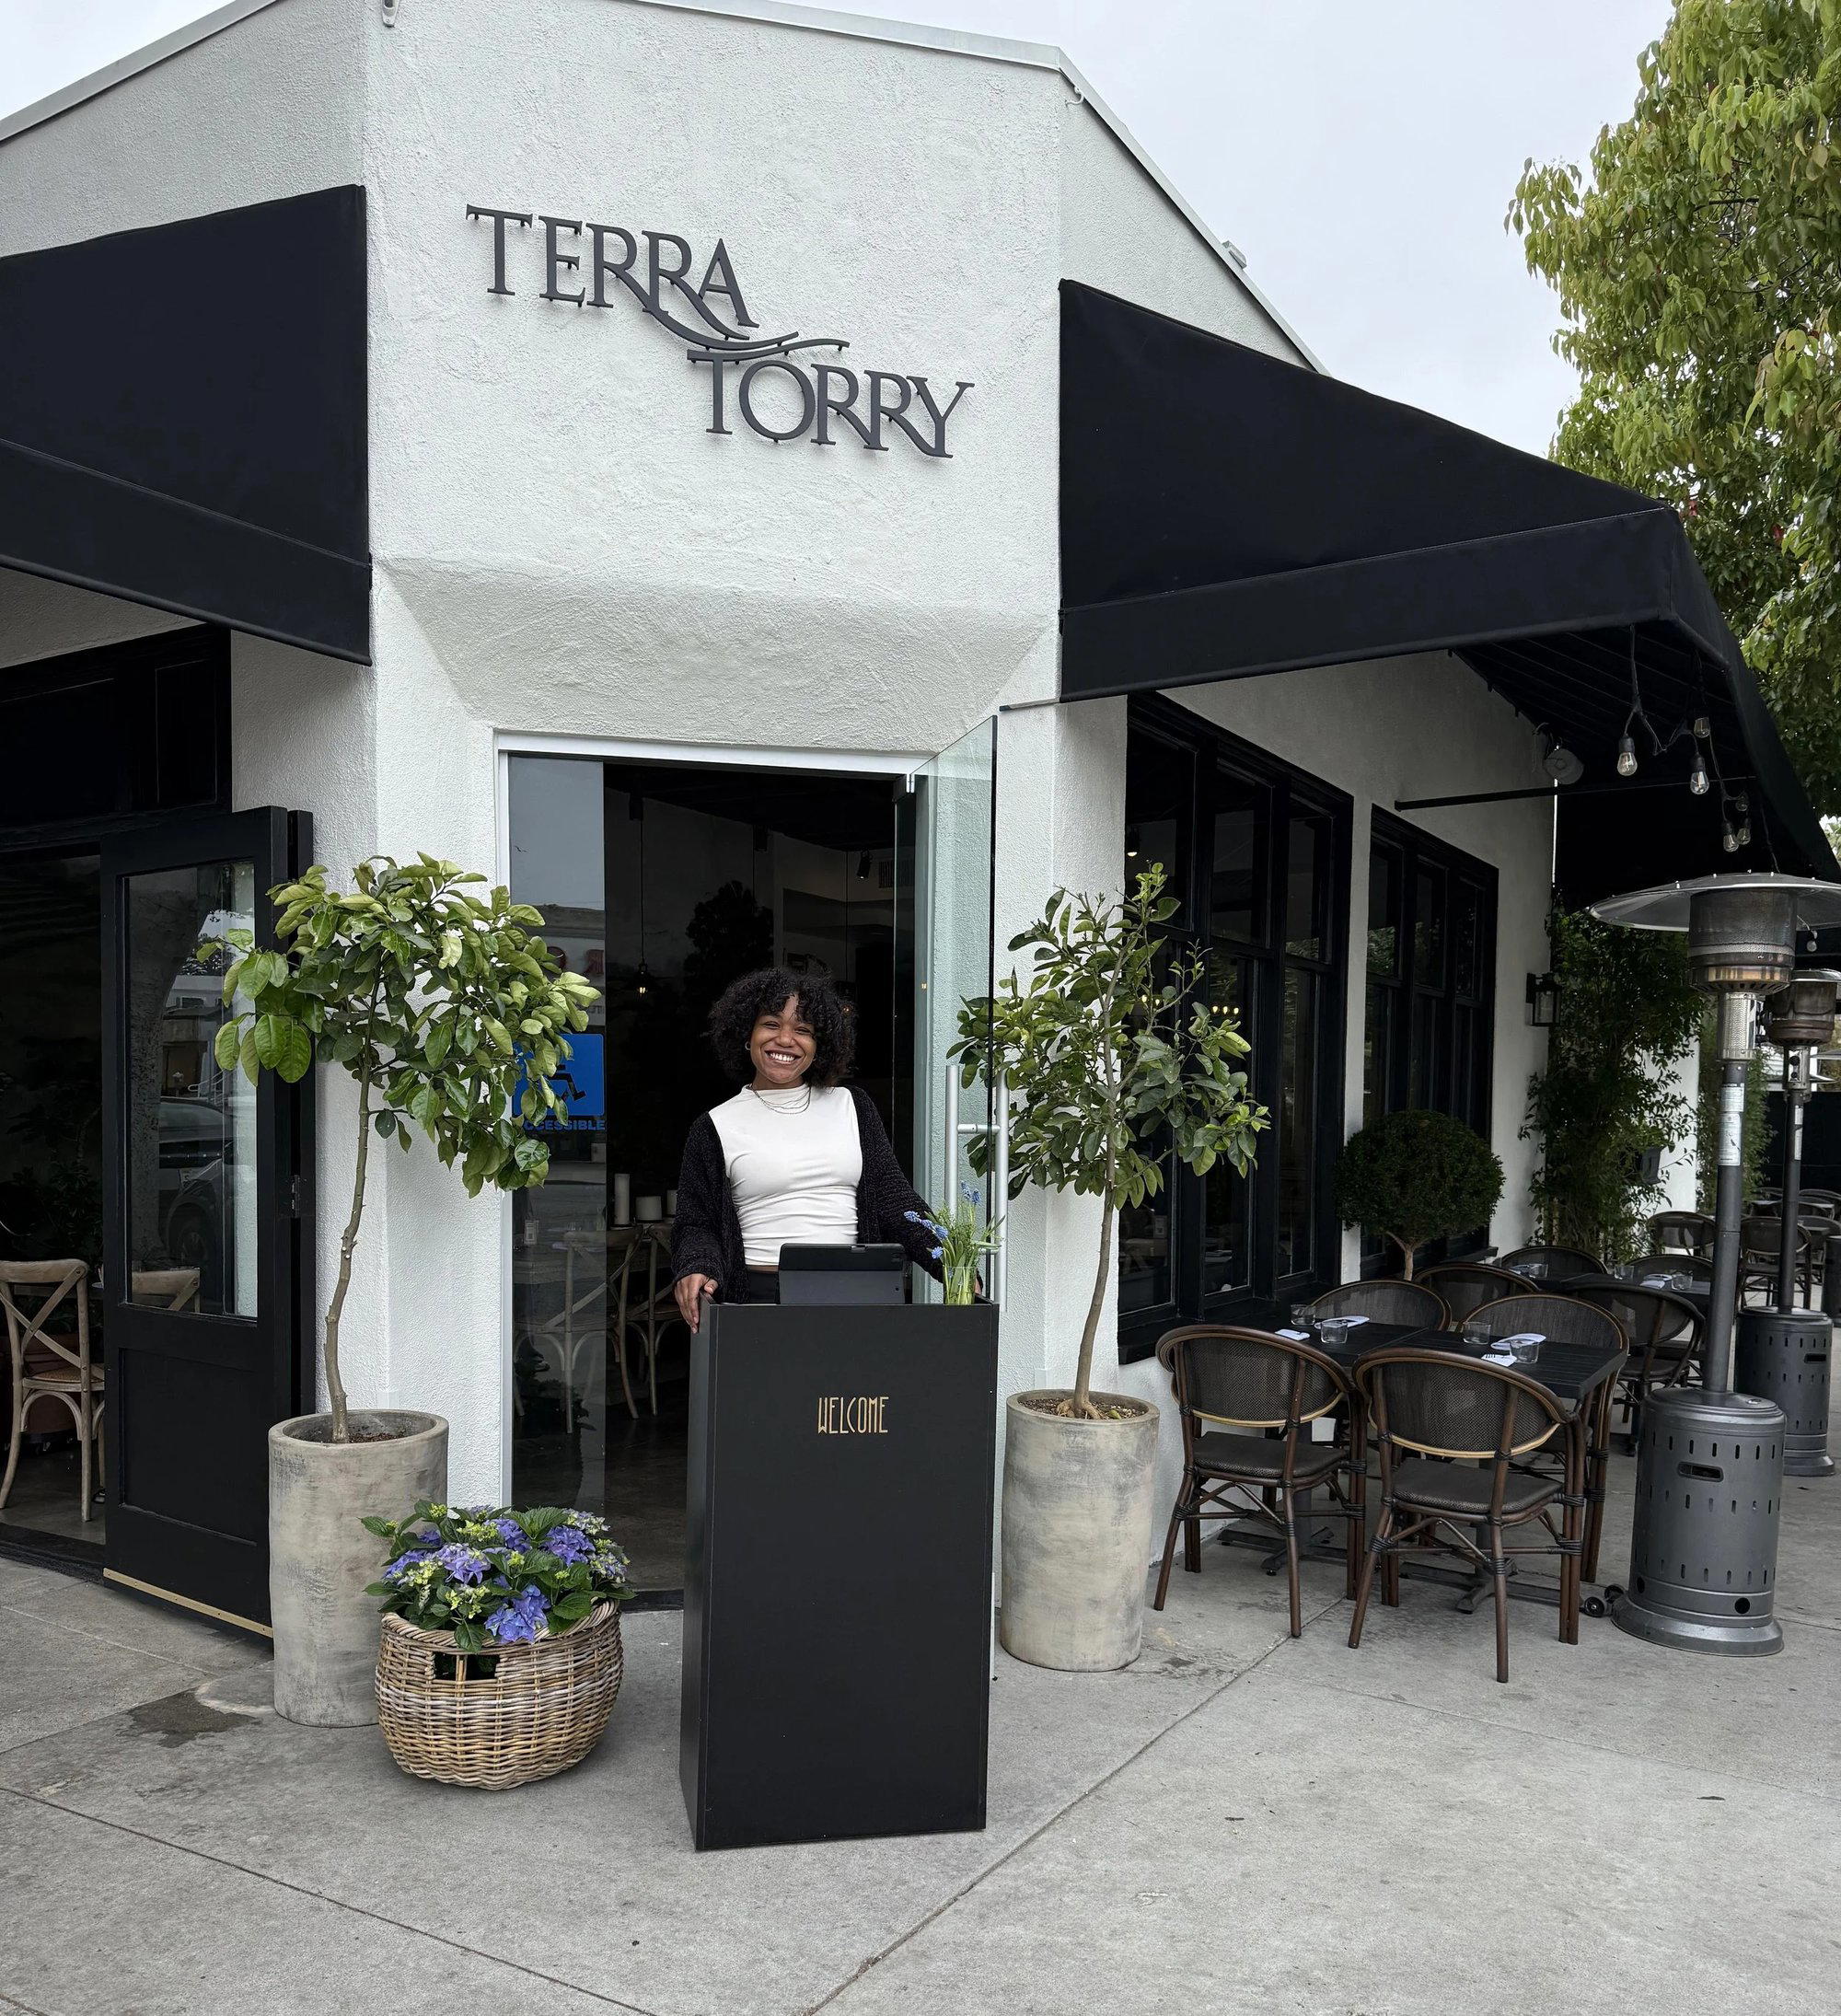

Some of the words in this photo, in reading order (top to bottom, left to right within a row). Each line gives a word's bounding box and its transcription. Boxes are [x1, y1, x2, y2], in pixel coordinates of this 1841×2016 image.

[466, 203, 799, 351] TERRA
[687, 338, 975, 459] TORRY
[522, 1119, 606, 1130] CCESSIBLE
[817, 1396, 889, 1433] WELCOME
